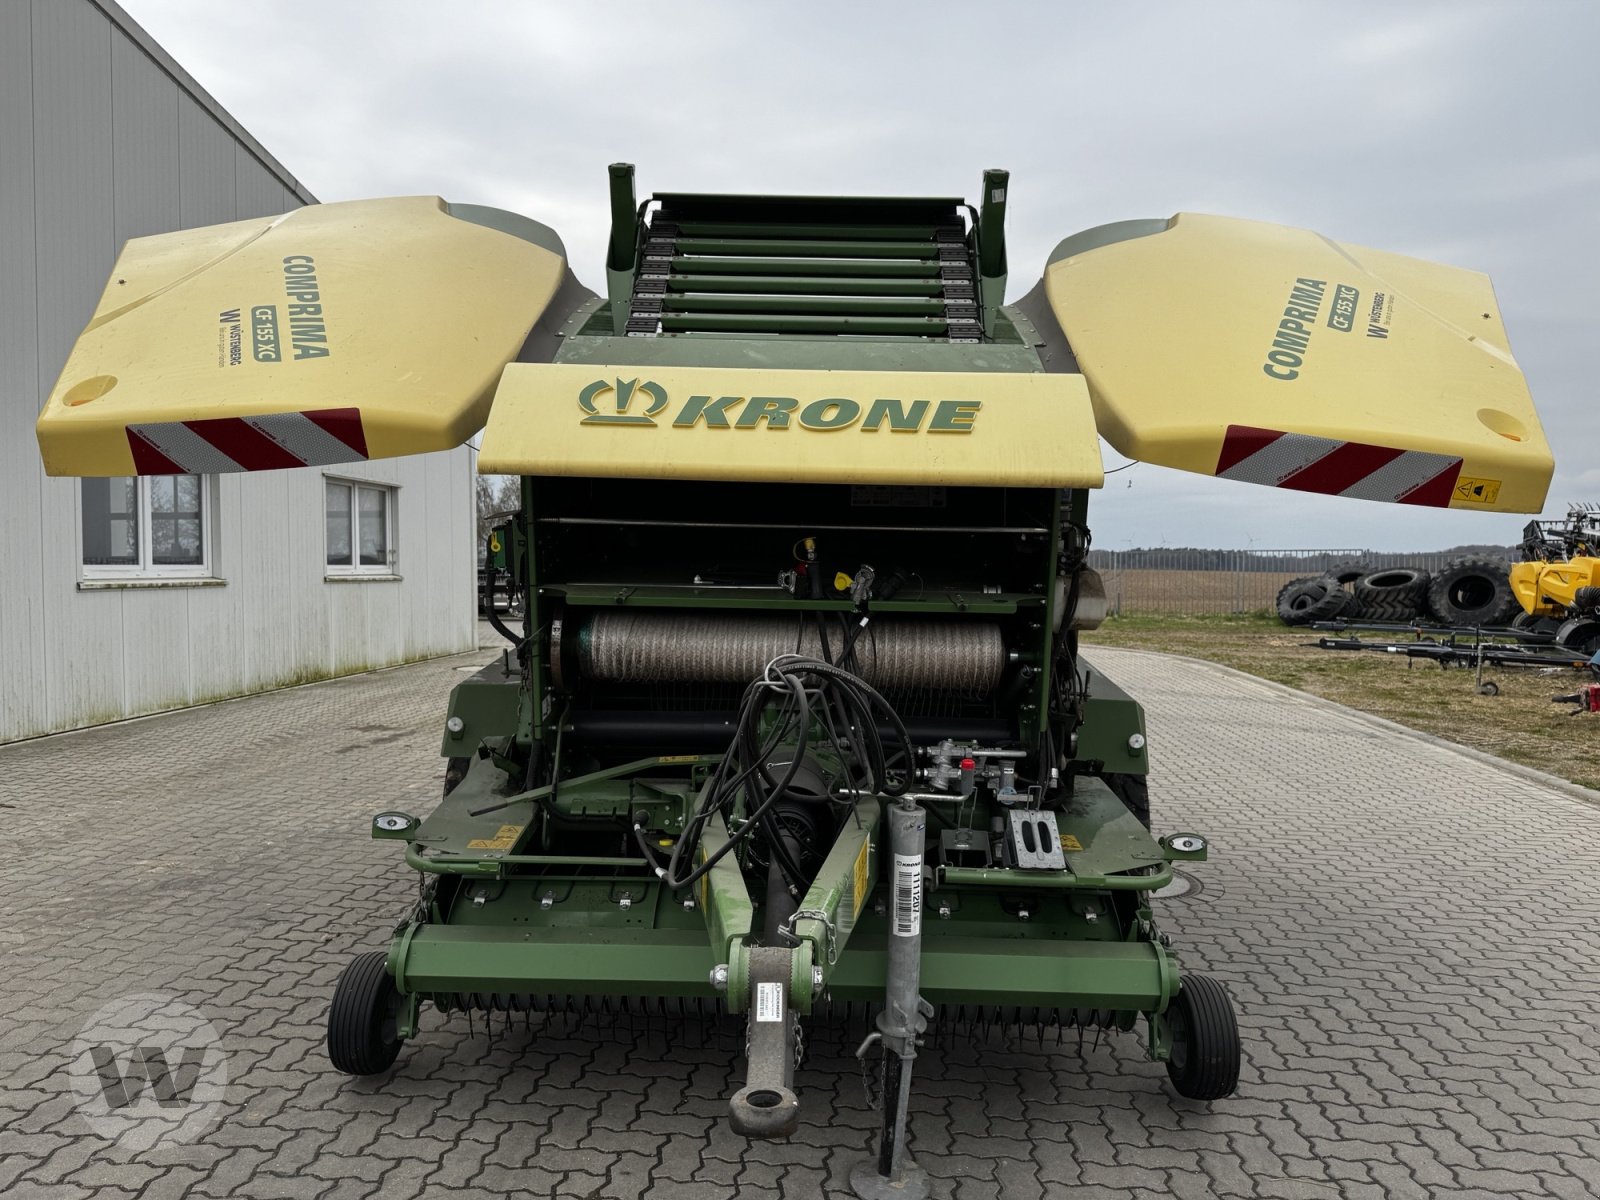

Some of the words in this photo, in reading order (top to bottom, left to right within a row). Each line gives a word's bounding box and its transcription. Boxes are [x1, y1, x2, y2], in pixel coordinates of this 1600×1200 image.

[1340, 287, 1356, 301] XC
[219, 308, 241, 323] W
[255, 308, 272, 320] CF
[283, 255, 330, 360] COMPRIMA
[1336, 299, 1354, 316] 155
[1263, 277, 1327, 381] COMPRIMA
[1332, 315, 1349, 329] CF
[256, 323, 274, 341] 155
[1366, 323, 1389, 339] W
[230, 323, 244, 366] WÜSTENBERG
[257, 343, 276, 359] XC
[672, 395, 983, 434] KRONE
[912, 871, 921, 913] 1111207
